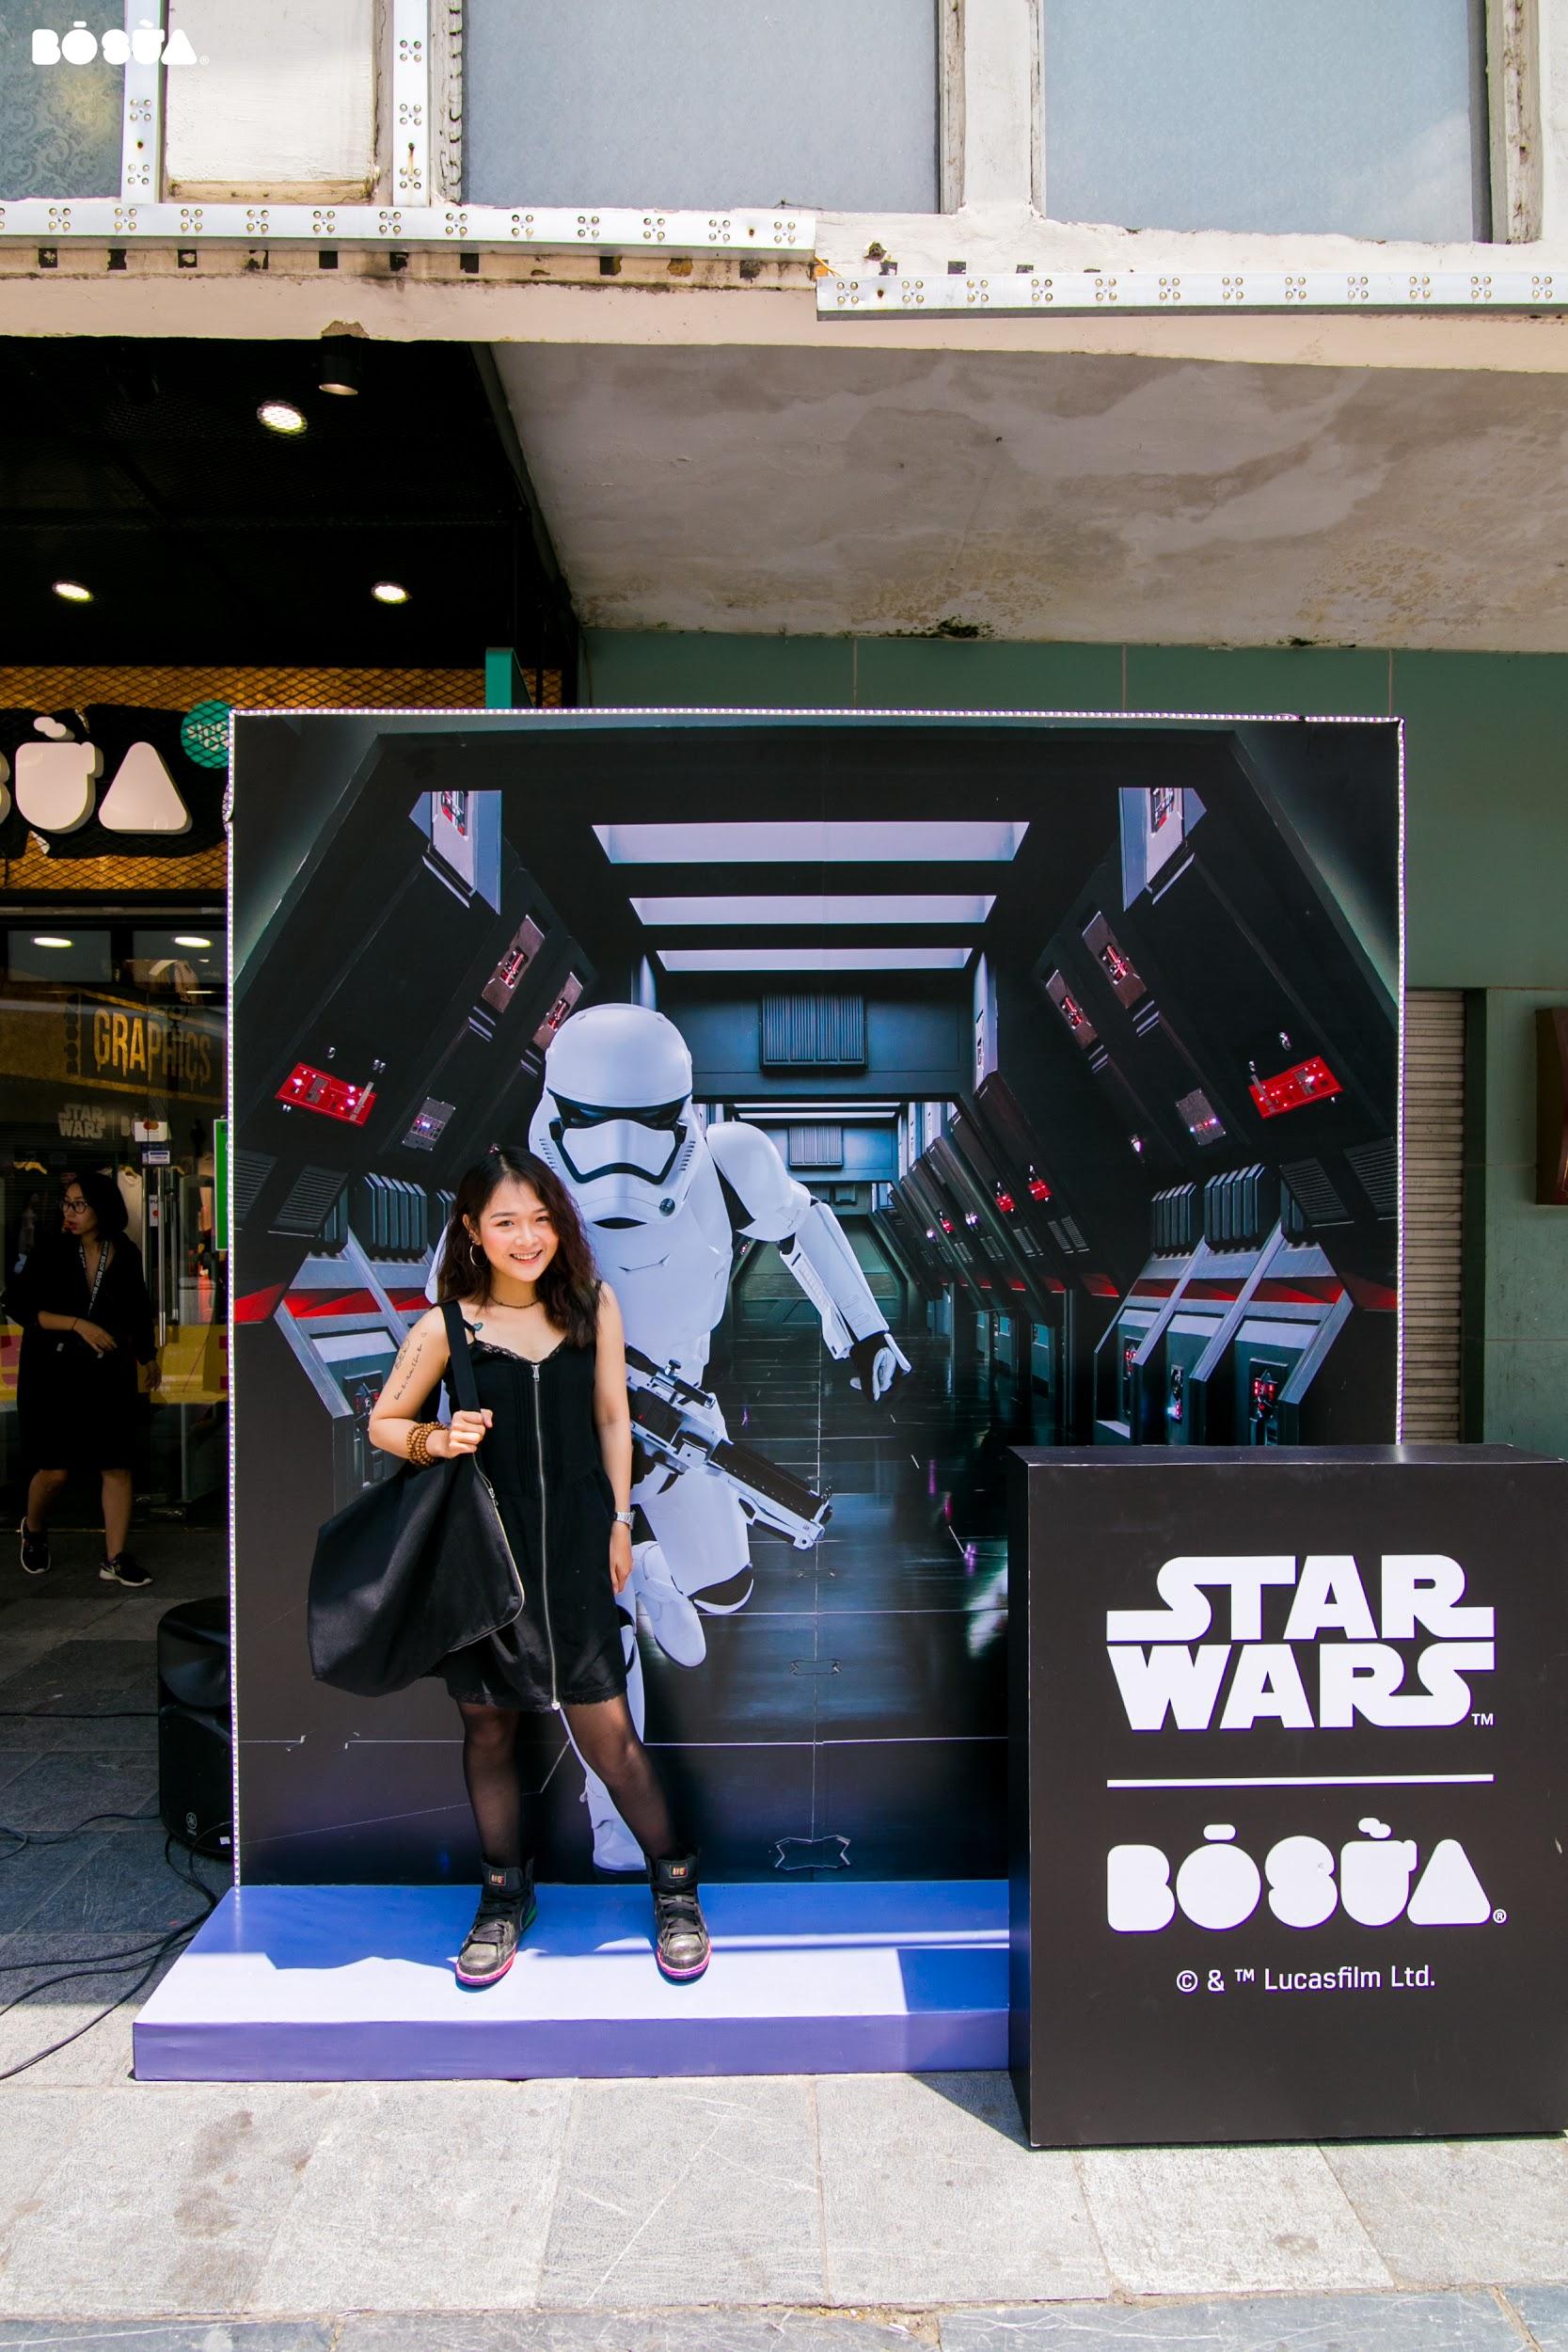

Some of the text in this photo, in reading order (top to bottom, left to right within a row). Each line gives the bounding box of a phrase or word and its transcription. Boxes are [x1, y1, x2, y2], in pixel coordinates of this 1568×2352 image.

[94, 1008, 211, 1091] GRAPHICS
[58, 1104, 105, 1121] STAR
[59, 1120, 105, 1138] WARS
[1106, 1554, 1495, 1642] STAR
[1106, 1642, 1495, 1731] WARS
[1207, 1969, 1225, 1992] &
[1264, 1965, 1381, 1990] Lucasfilm
[1390, 1964, 1435, 1987] Ltd.
